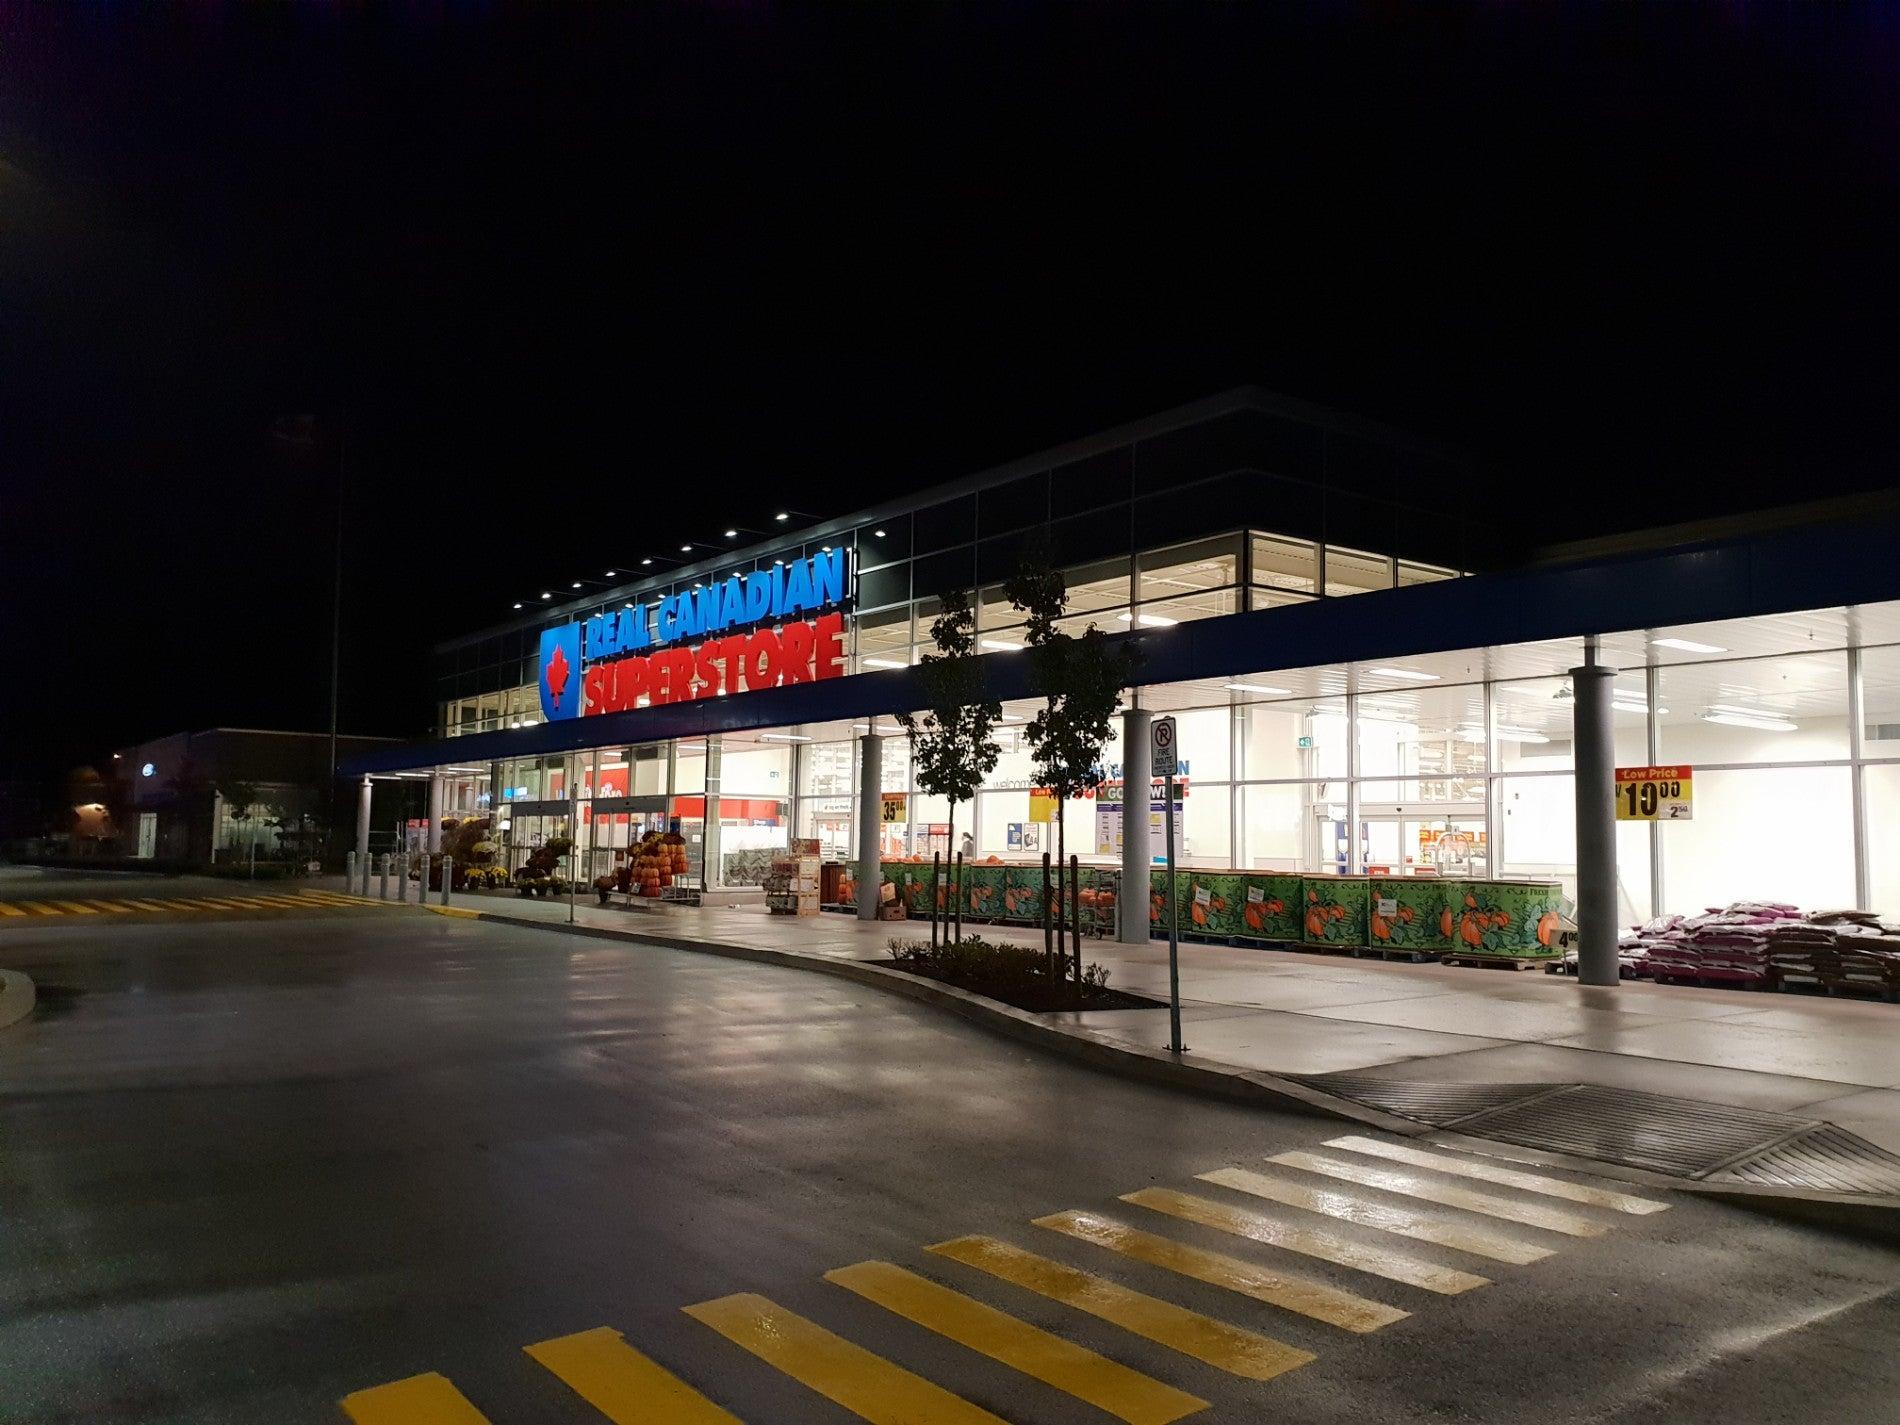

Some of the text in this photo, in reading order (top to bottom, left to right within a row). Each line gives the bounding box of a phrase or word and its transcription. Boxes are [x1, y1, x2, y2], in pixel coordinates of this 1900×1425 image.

[585, 546, 845, 660] REAL CANADIAN
[583, 612, 845, 718] SUPERSTORE
[1157, 748, 1170, 757] FIRE
[1154, 756, 1173, 766] ROUTE
[1623, 767, 1678, 779] Low Price
